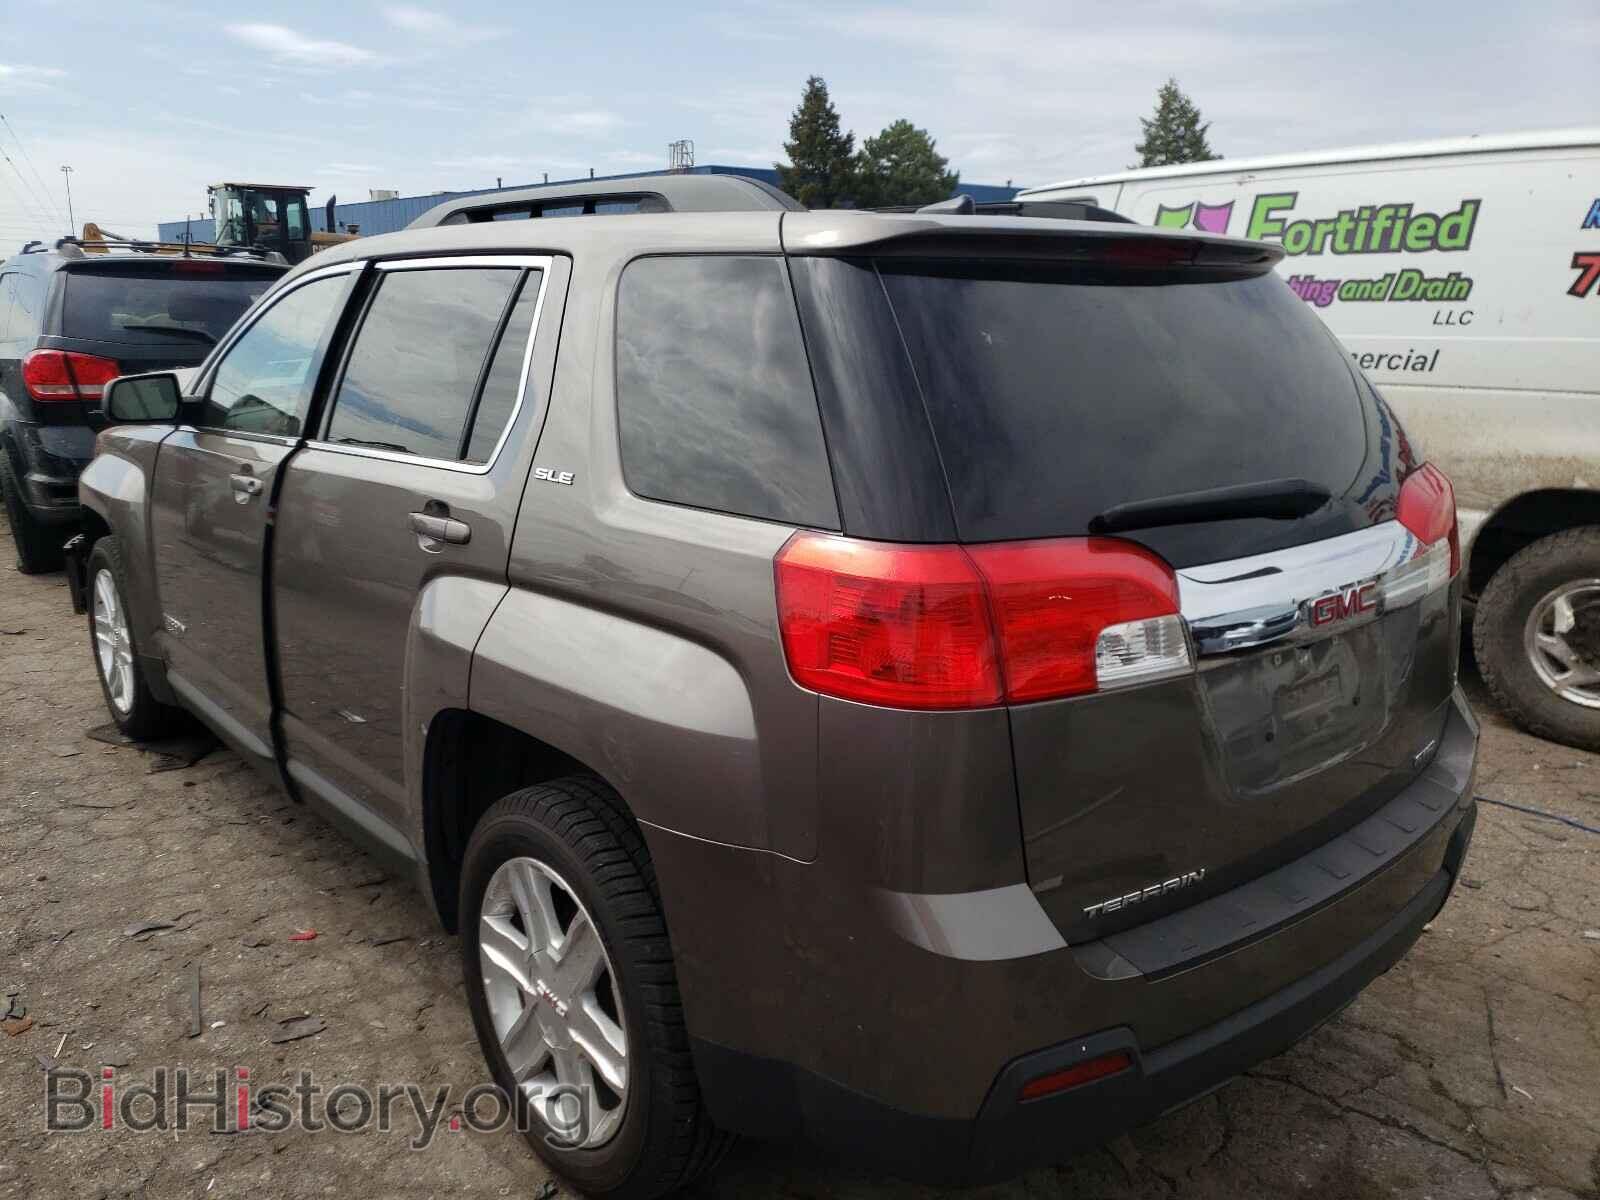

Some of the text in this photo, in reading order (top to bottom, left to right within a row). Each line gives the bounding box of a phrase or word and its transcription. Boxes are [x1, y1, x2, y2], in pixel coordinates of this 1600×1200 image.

[1246, 191, 1482, 256] Fortified
[1338, 273, 1397, 302] and
[1388, 268, 1474, 302] Drain
[1432, 309, 1474, 326] LLC
[1351, 348, 1440, 372] ercial
[534, 467, 575, 485] SLE
[1311, 580, 1377, 625] GMC
[1083, 868, 1205, 918] TERRAIN
